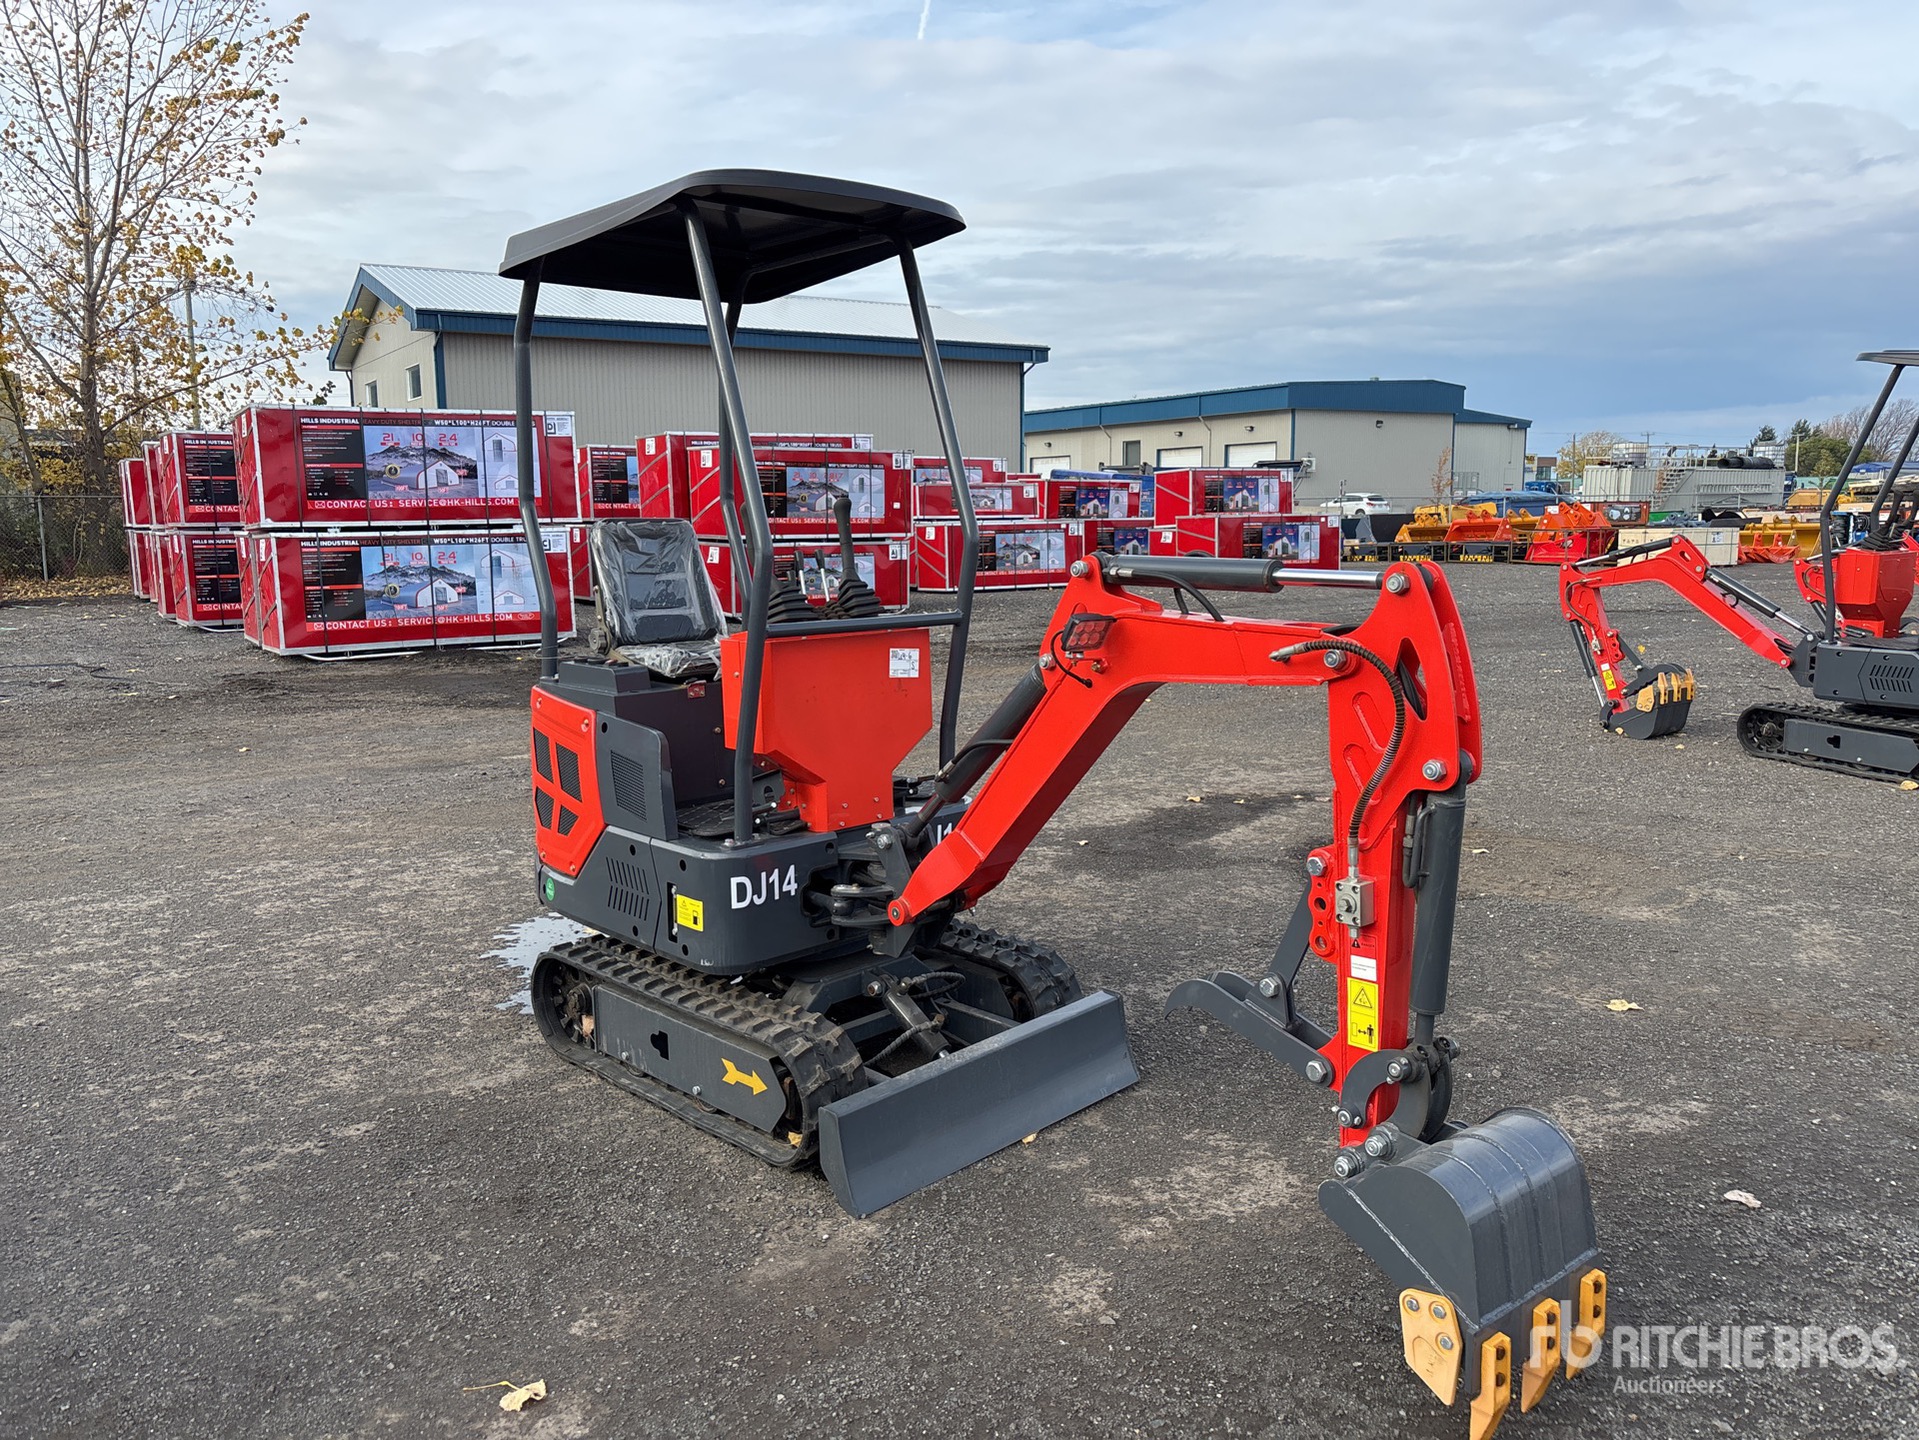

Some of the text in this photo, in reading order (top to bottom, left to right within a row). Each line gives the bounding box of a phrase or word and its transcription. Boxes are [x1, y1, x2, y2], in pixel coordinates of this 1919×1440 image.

[320, 417, 360, 425] INDUSTRIAL
[320, 539, 360, 547] INDUSTRIAL
[326, 620, 370, 631] CONTACT
[730, 864, 798, 910] DJ14
